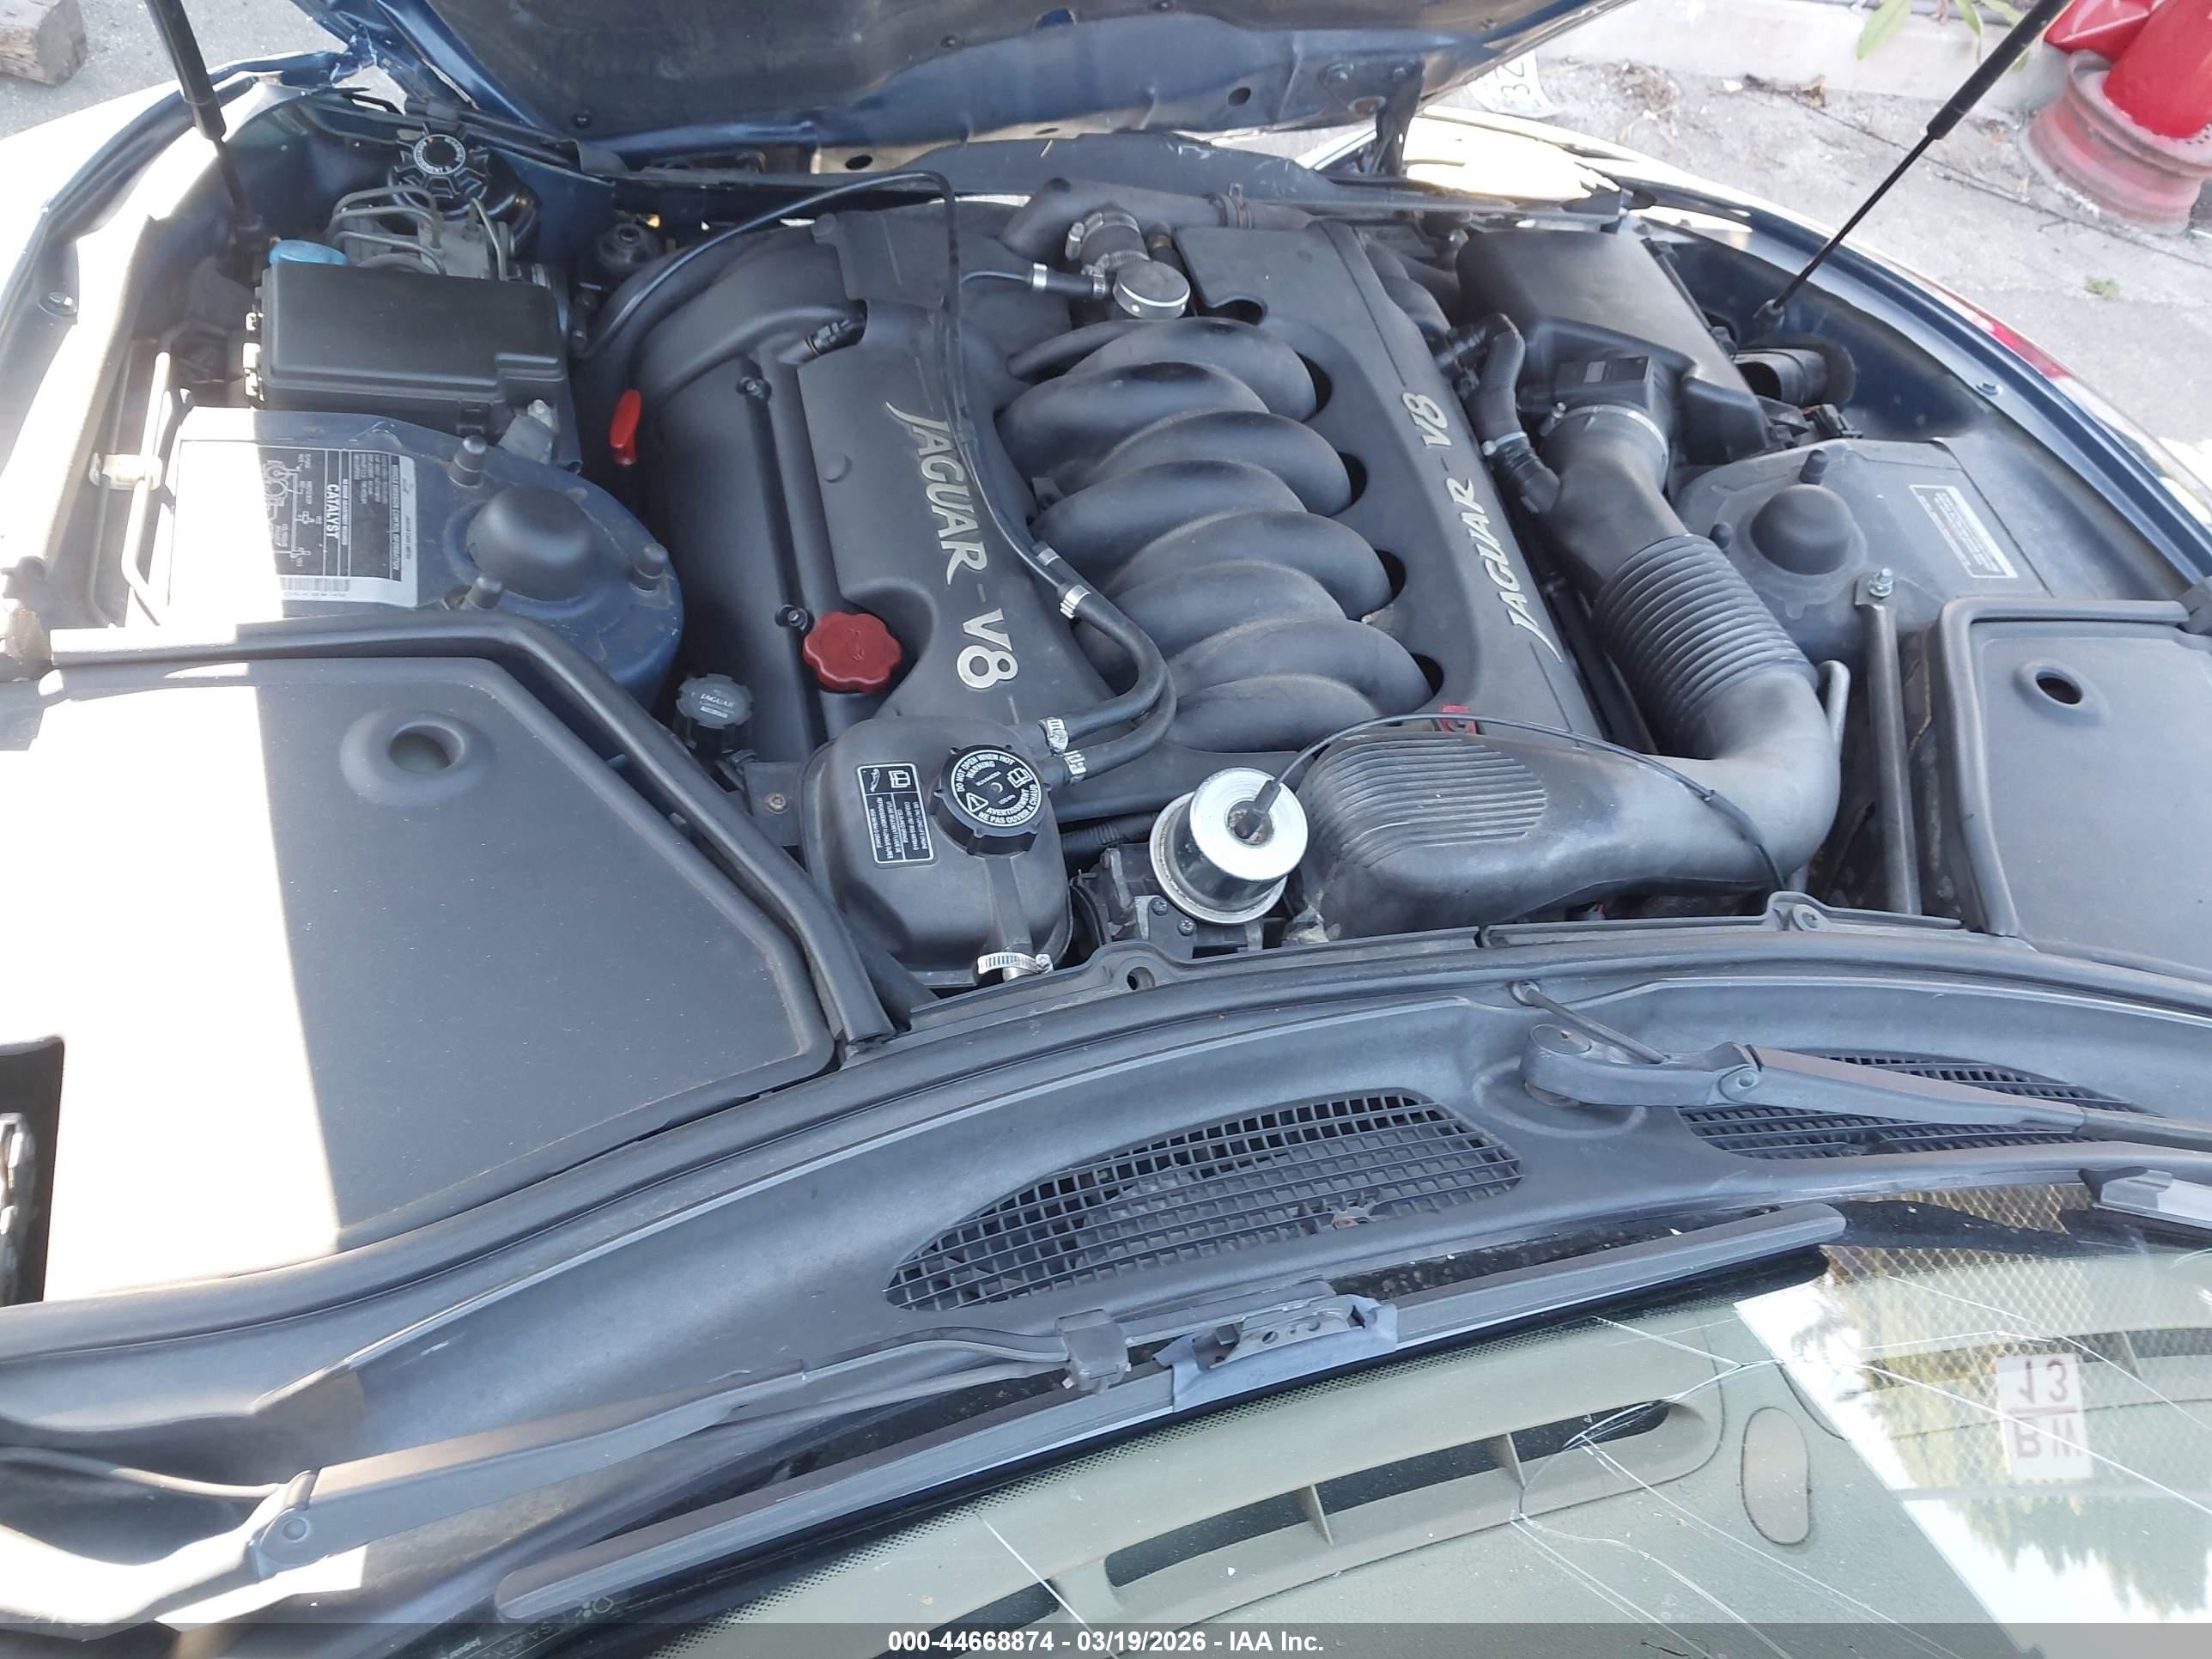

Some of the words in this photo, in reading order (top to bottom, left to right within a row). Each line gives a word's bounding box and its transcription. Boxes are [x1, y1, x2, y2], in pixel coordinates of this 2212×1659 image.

[1401, 392, 1452, 449] V8
[326, 483, 339, 539] CATALYST
[885, 400, 988, 586] JAGUAR
[957, 608, 1019, 690] V8
[1446, 477, 1564, 664] JAGUAR
[961, 757, 978, 770] OPEN
[966, 761, 995, 779] WARNING
[999, 755, 1015, 766] HOT
[956, 769, 966, 782] NOT
[956, 782, 965, 793] DO
[978, 811, 990, 821] NE
[990, 815, 1006, 823] PAS
[1029, 784, 1038, 805] CHAUD
